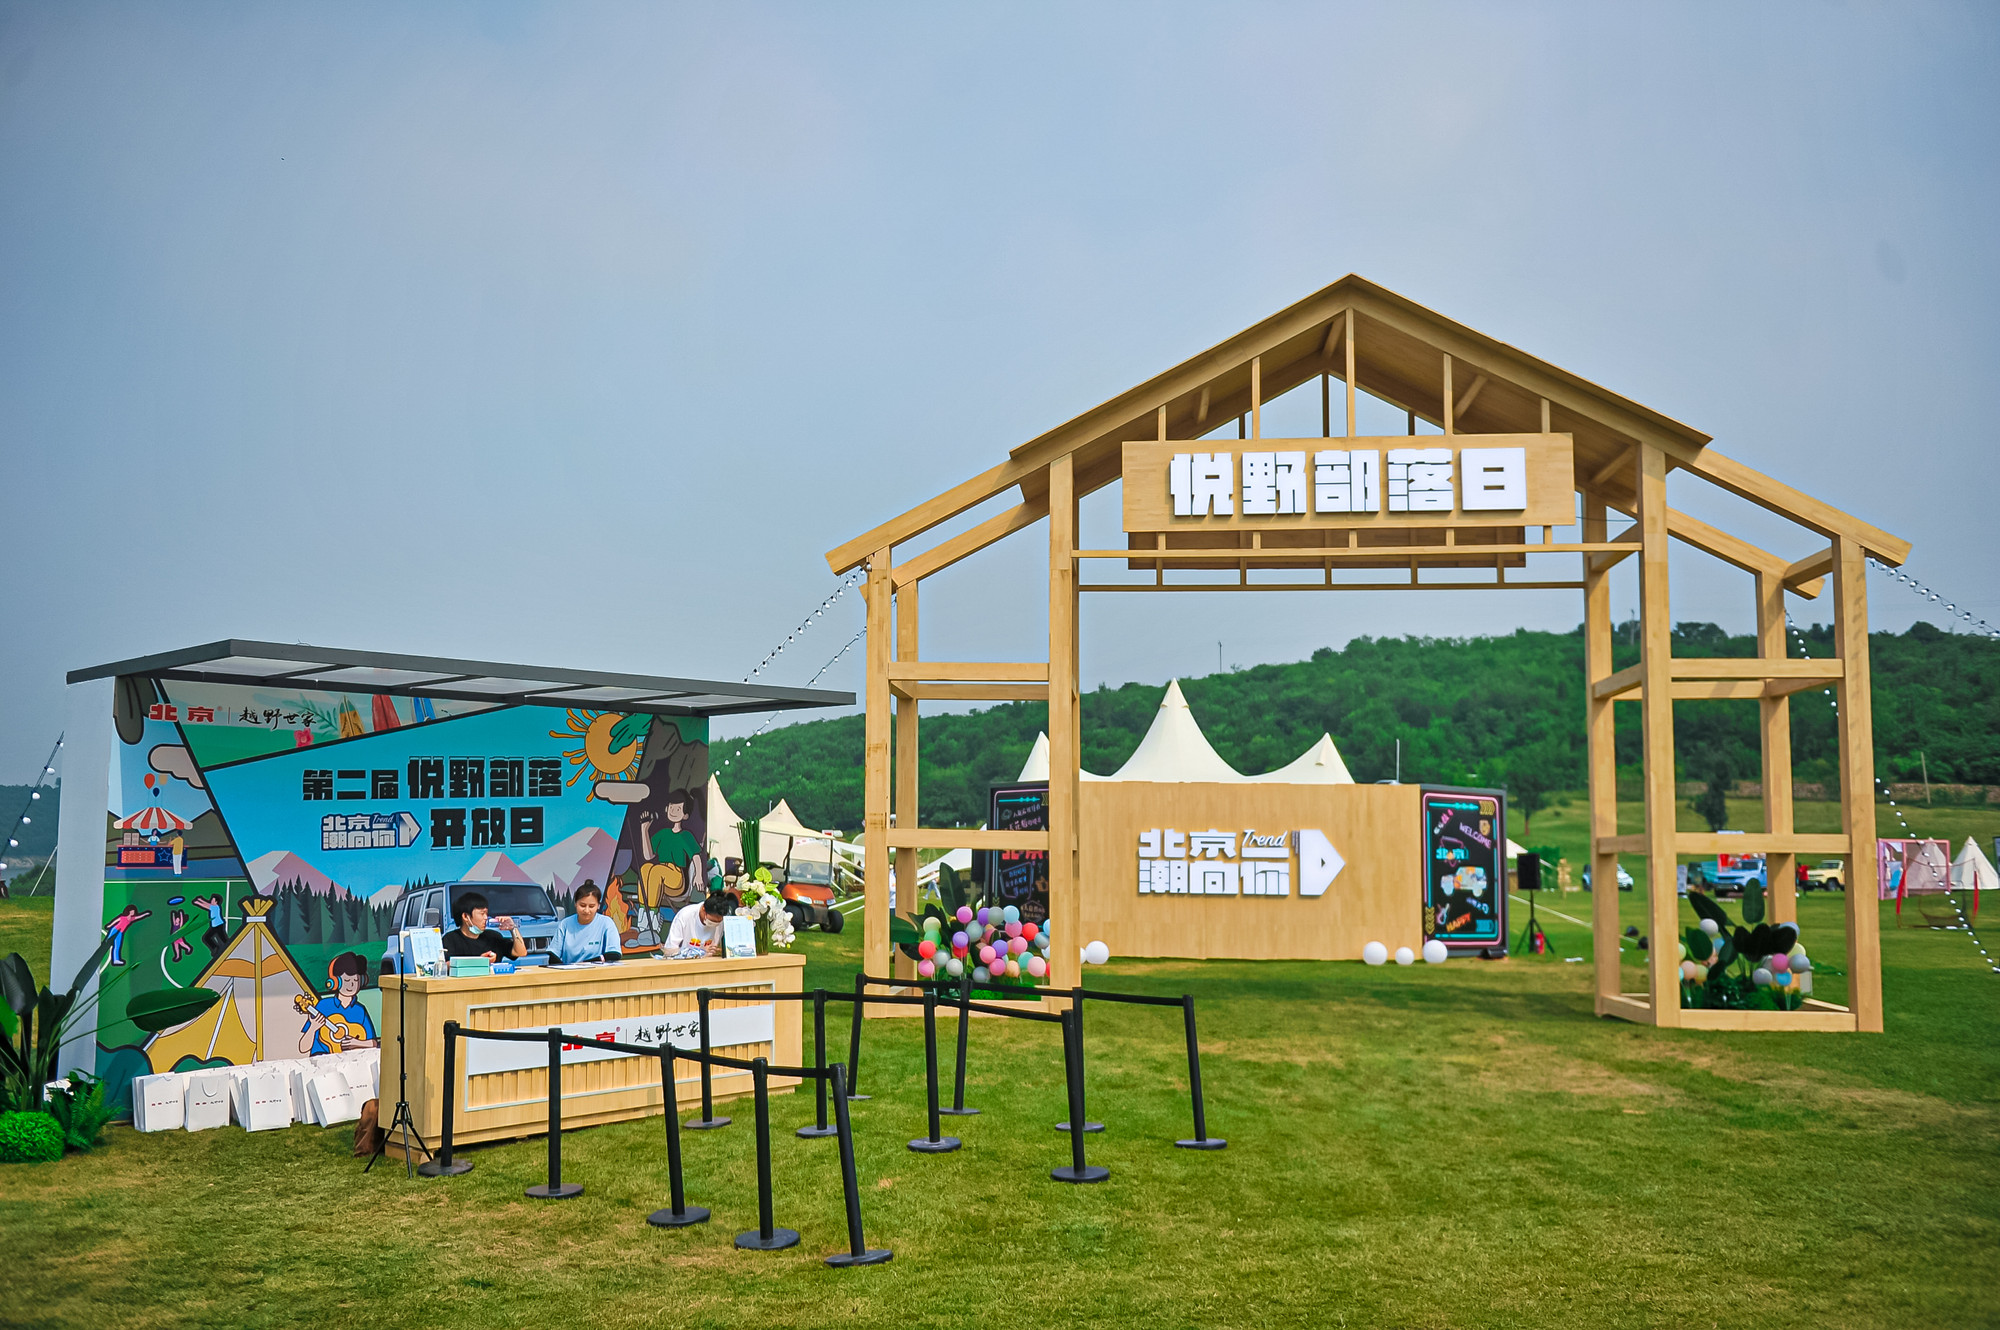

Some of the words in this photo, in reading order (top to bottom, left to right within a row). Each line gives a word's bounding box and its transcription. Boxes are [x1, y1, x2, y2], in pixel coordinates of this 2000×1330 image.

[1170, 447, 1526, 516] 悦野部落日
[150, 704, 215, 723] 北京
[238, 706, 317, 731] 越野世家
[323, 815, 371, 832] 北京
[372, 814, 395, 824] Trend
[430, 806, 544, 851] 开放日
[1459, 822, 1492, 849] WELCOME
[1138, 829, 1237, 859] 北京
[1241, 829, 1289, 847] Trend
[634, 1020, 700, 1043] 越野世家
